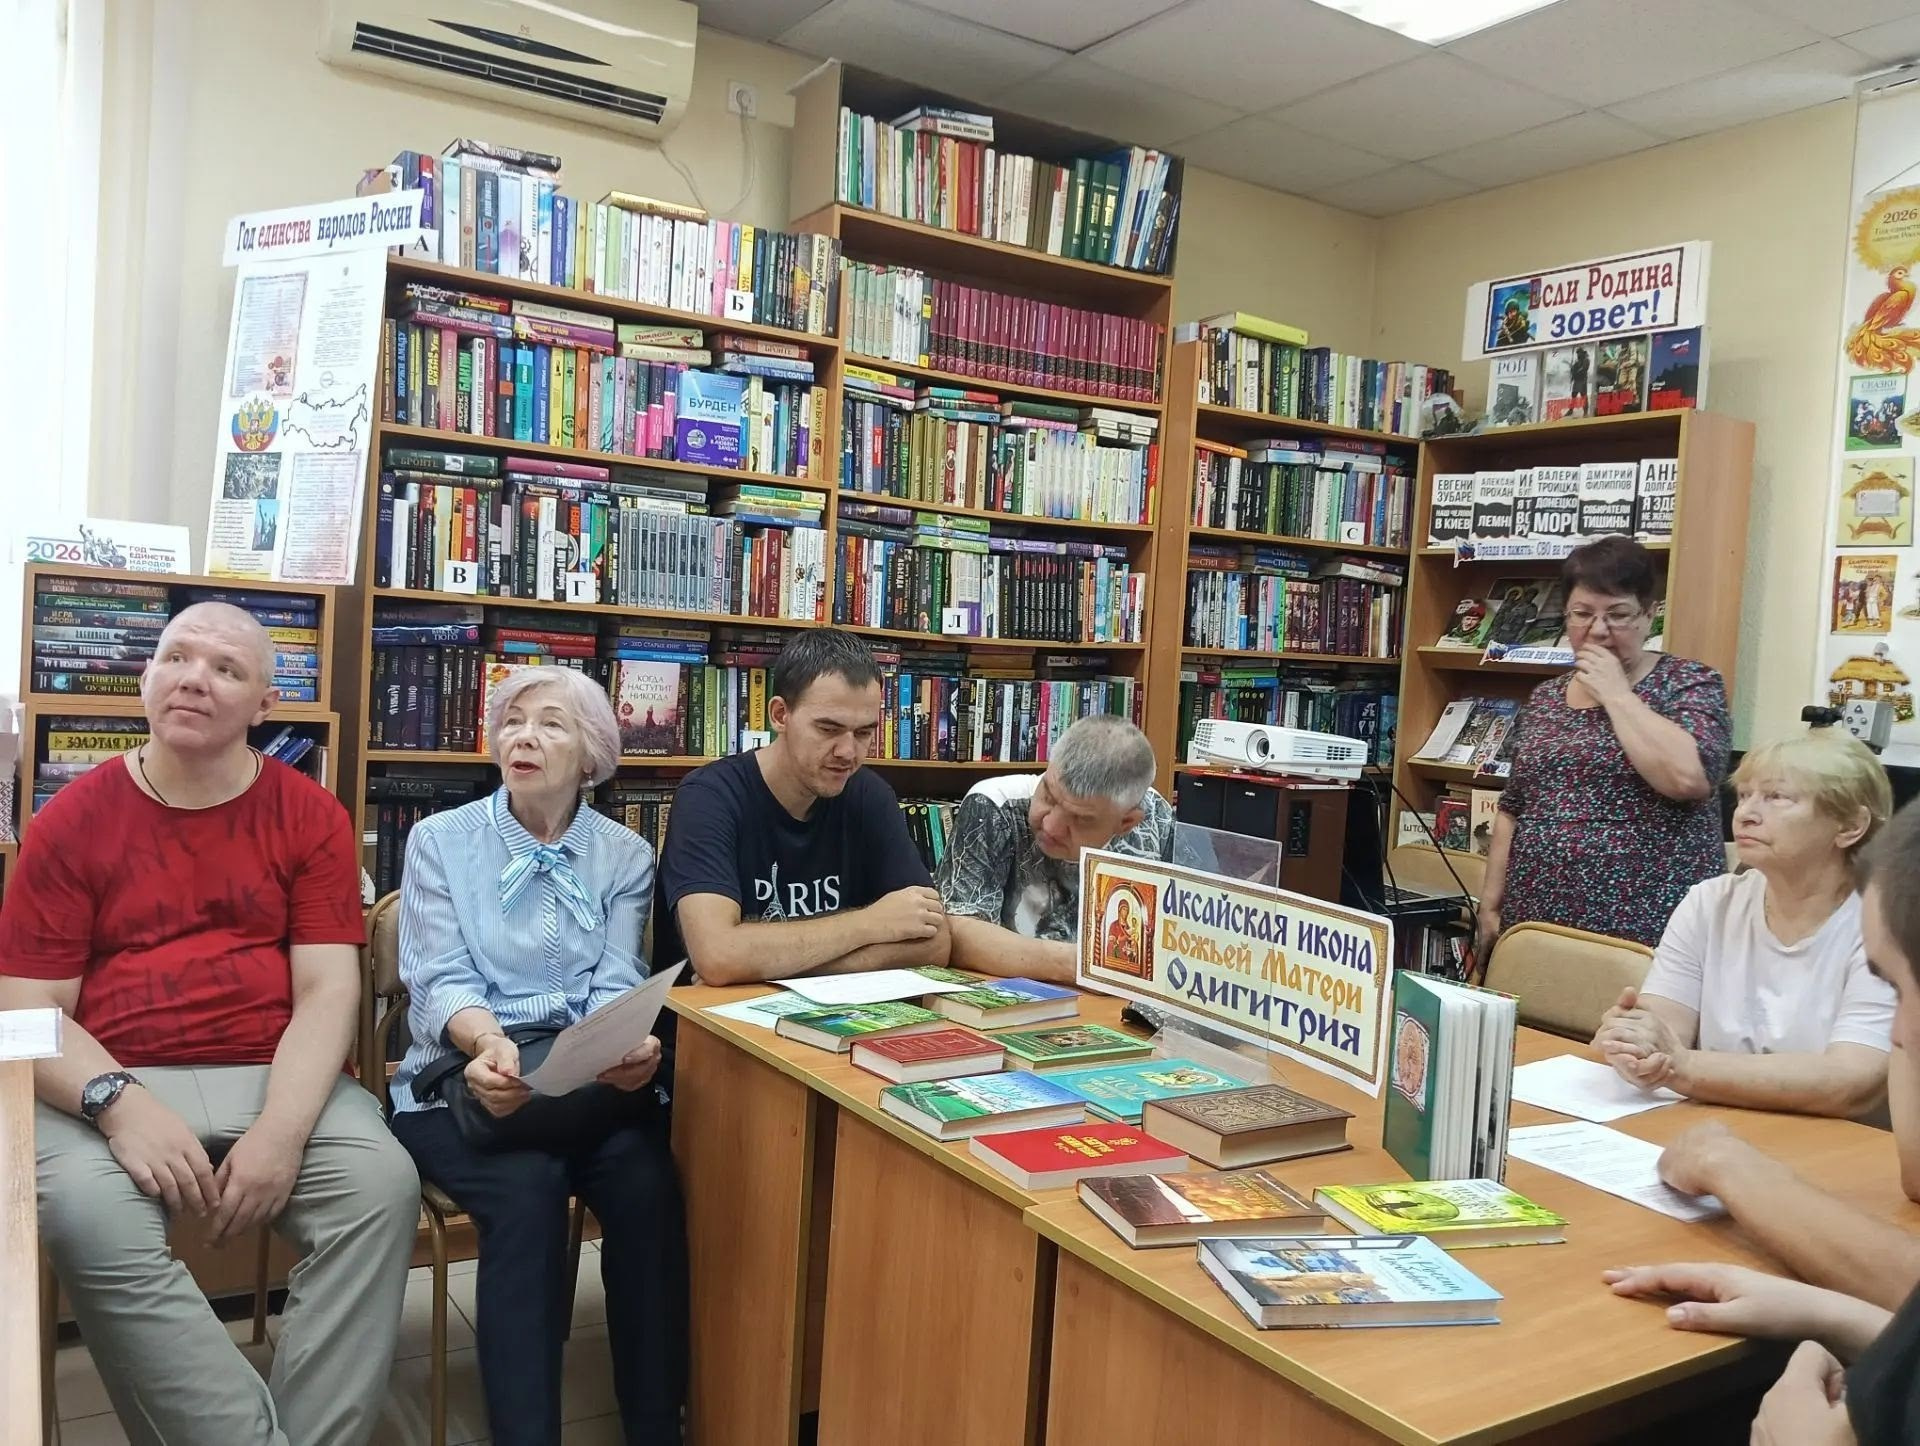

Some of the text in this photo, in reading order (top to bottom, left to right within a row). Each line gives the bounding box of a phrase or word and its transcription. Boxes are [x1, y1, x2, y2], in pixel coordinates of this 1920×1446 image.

[1883, 208, 1918, 224] 2026
[237, 201, 412, 252] Год единства народов России
[413, 235, 429, 252] А
[1528, 262, 1673, 310] Если Родина
[732, 295, 745, 312] Б
[1550, 290, 1661, 339] зовет!
[1497, 357, 1528, 376] РОЙ
[689, 398, 736, 413] БУРДЕН
[1538, 471, 1579, 481] ВАЛЕРИ
[1587, 469, 1633, 480] ДМИТРИЙ
[1646, 464, 1677, 481] АНН
[1438, 479, 1473, 491] ЕВГЕНИ
[1481, 478, 1515, 486] АЛЕКСАН
[1537, 481, 1578, 493] ТРОИЦКА
[1586, 481, 1632, 490] ФИЛИППОВ
[1437, 491, 1473, 503] ЗУБАРЕ
[1480, 487, 1514, 497] ПРОХАН
[1525, 499, 1532, 509] Т
[1535, 498, 1578, 509] ДОНЕЦКО
[1583, 504, 1631, 514] СОБИРАТЕЛИ
[1643, 497, 1675, 511] Я ЗДЕ
[1435, 518, 1470, 530] В КИЕВ
[1583, 515, 1630, 528] ТИШИНЫ
[1346, 527, 1359, 540] С
[1515, 525, 1530, 536] РУ
[27, 541, 81, 561] 2026
[129, 545, 147, 553] ГОД
[129, 552, 176, 562] ЕДИНСТВА
[129, 559, 172, 568] НАРОДОВ
[453, 567, 467, 584] В
[572, 580, 586, 597] Г
[948, 615, 962, 628] Л
[637, 674, 664, 683] КОГДА
[627, 684, 673, 693] НАСТУПИТ
[629, 692, 669, 702] НИКОГДА
[67, 736, 122, 749] ЗОЛОТАЯ
[1403, 823, 1434, 834] ШТОР
[1162, 878, 1373, 975] Аксайская икона
[1161, 918, 1363, 1016] Божьей Матери
[1166, 956, 1362, 1057] Одигитрия
